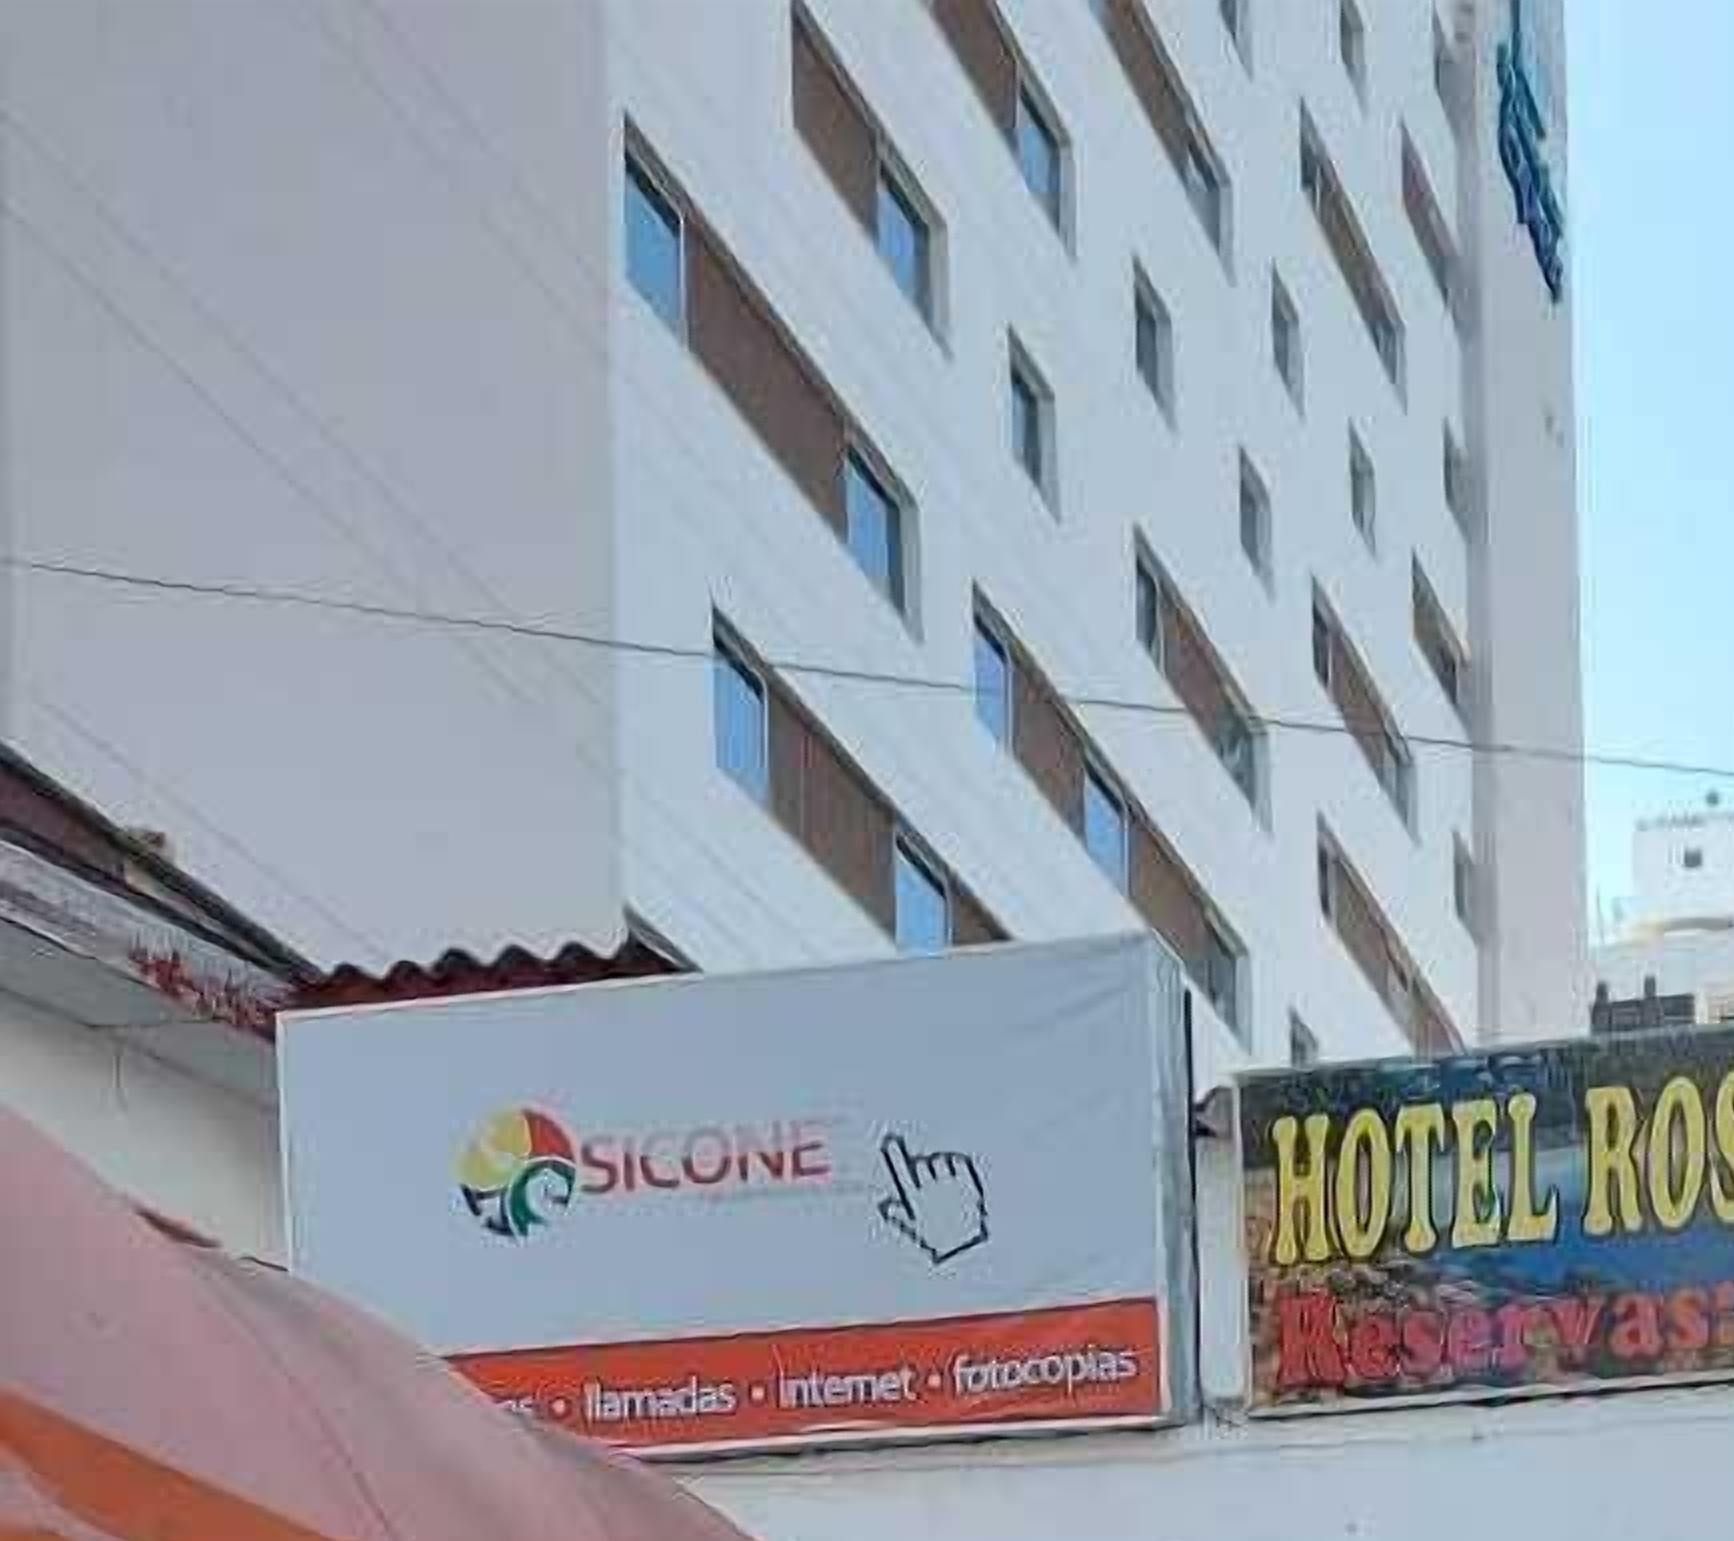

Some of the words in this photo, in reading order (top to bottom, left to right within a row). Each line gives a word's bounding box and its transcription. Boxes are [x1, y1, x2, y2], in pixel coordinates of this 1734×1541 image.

[578, 1118, 832, 1194] SICONE
[1270, 1092, 1559, 1266] HOTEL
[584, 1375, 737, 1422] llamadas
[778, 1366, 916, 1408] internet
[953, 1344, 1138, 1399] fotocopias
